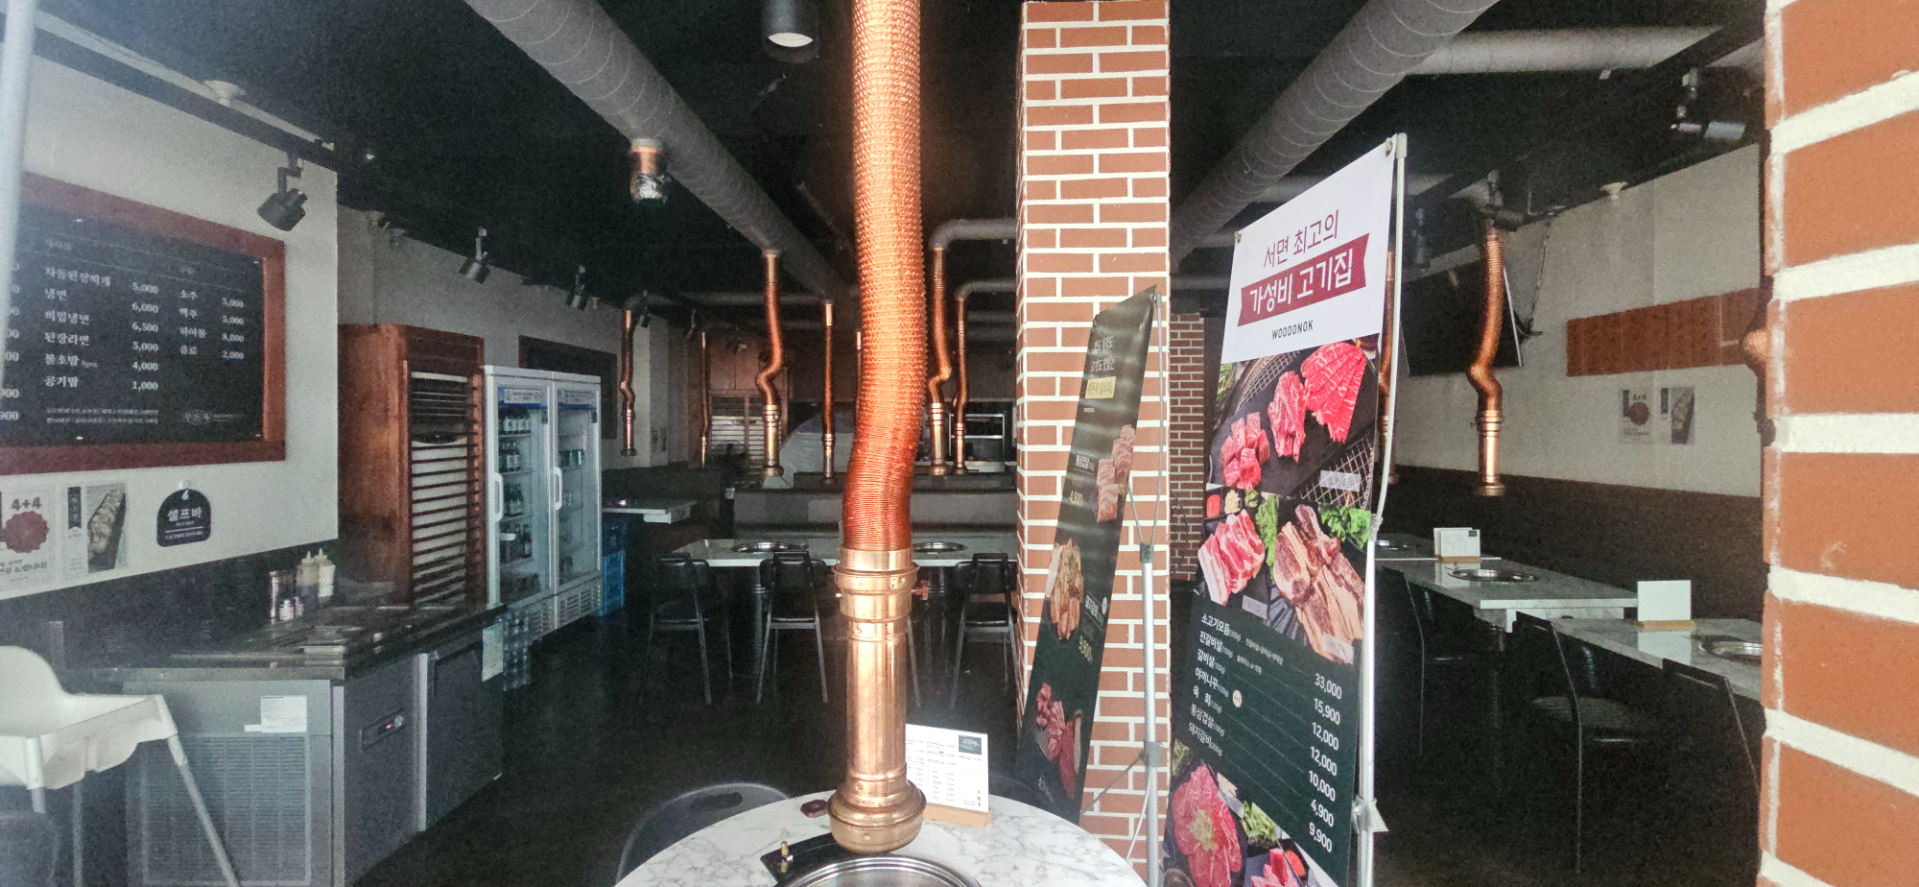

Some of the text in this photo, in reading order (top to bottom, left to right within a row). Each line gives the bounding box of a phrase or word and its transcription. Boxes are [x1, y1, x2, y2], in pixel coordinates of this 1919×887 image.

[1263, 209, 1339, 268] 서면 최고의
[132, 282, 159, 294] 5,000
[1250, 248, 1353, 315] 가성비 고기집
[179, 289, 198, 301] 소주
[131, 302, 159, 314] 6,000
[131, 321, 159, 333] 6,500
[1272, 319, 1314, 340] WOODONOK
[44, 332, 159, 352] 된장라면 5,000
[131, 361, 159, 372] 4,000
[44, 375, 159, 393] 공기밥 1,000
[11, 496, 42, 511] 4+4
[167, 506, 203, 522] 셀프바
[1314, 672, 1342, 700] 33,000
[1197, 648, 1216, 669] 갈비살
[1311, 722, 1340, 751] 12,000
[1313, 698, 1341, 726] 15,900
[1310, 746, 1338, 776] 12,000
[1308, 770, 1336, 802] 10,000
[1310, 799, 1334, 828] 4,900
[1309, 822, 1332, 852] 9,900
